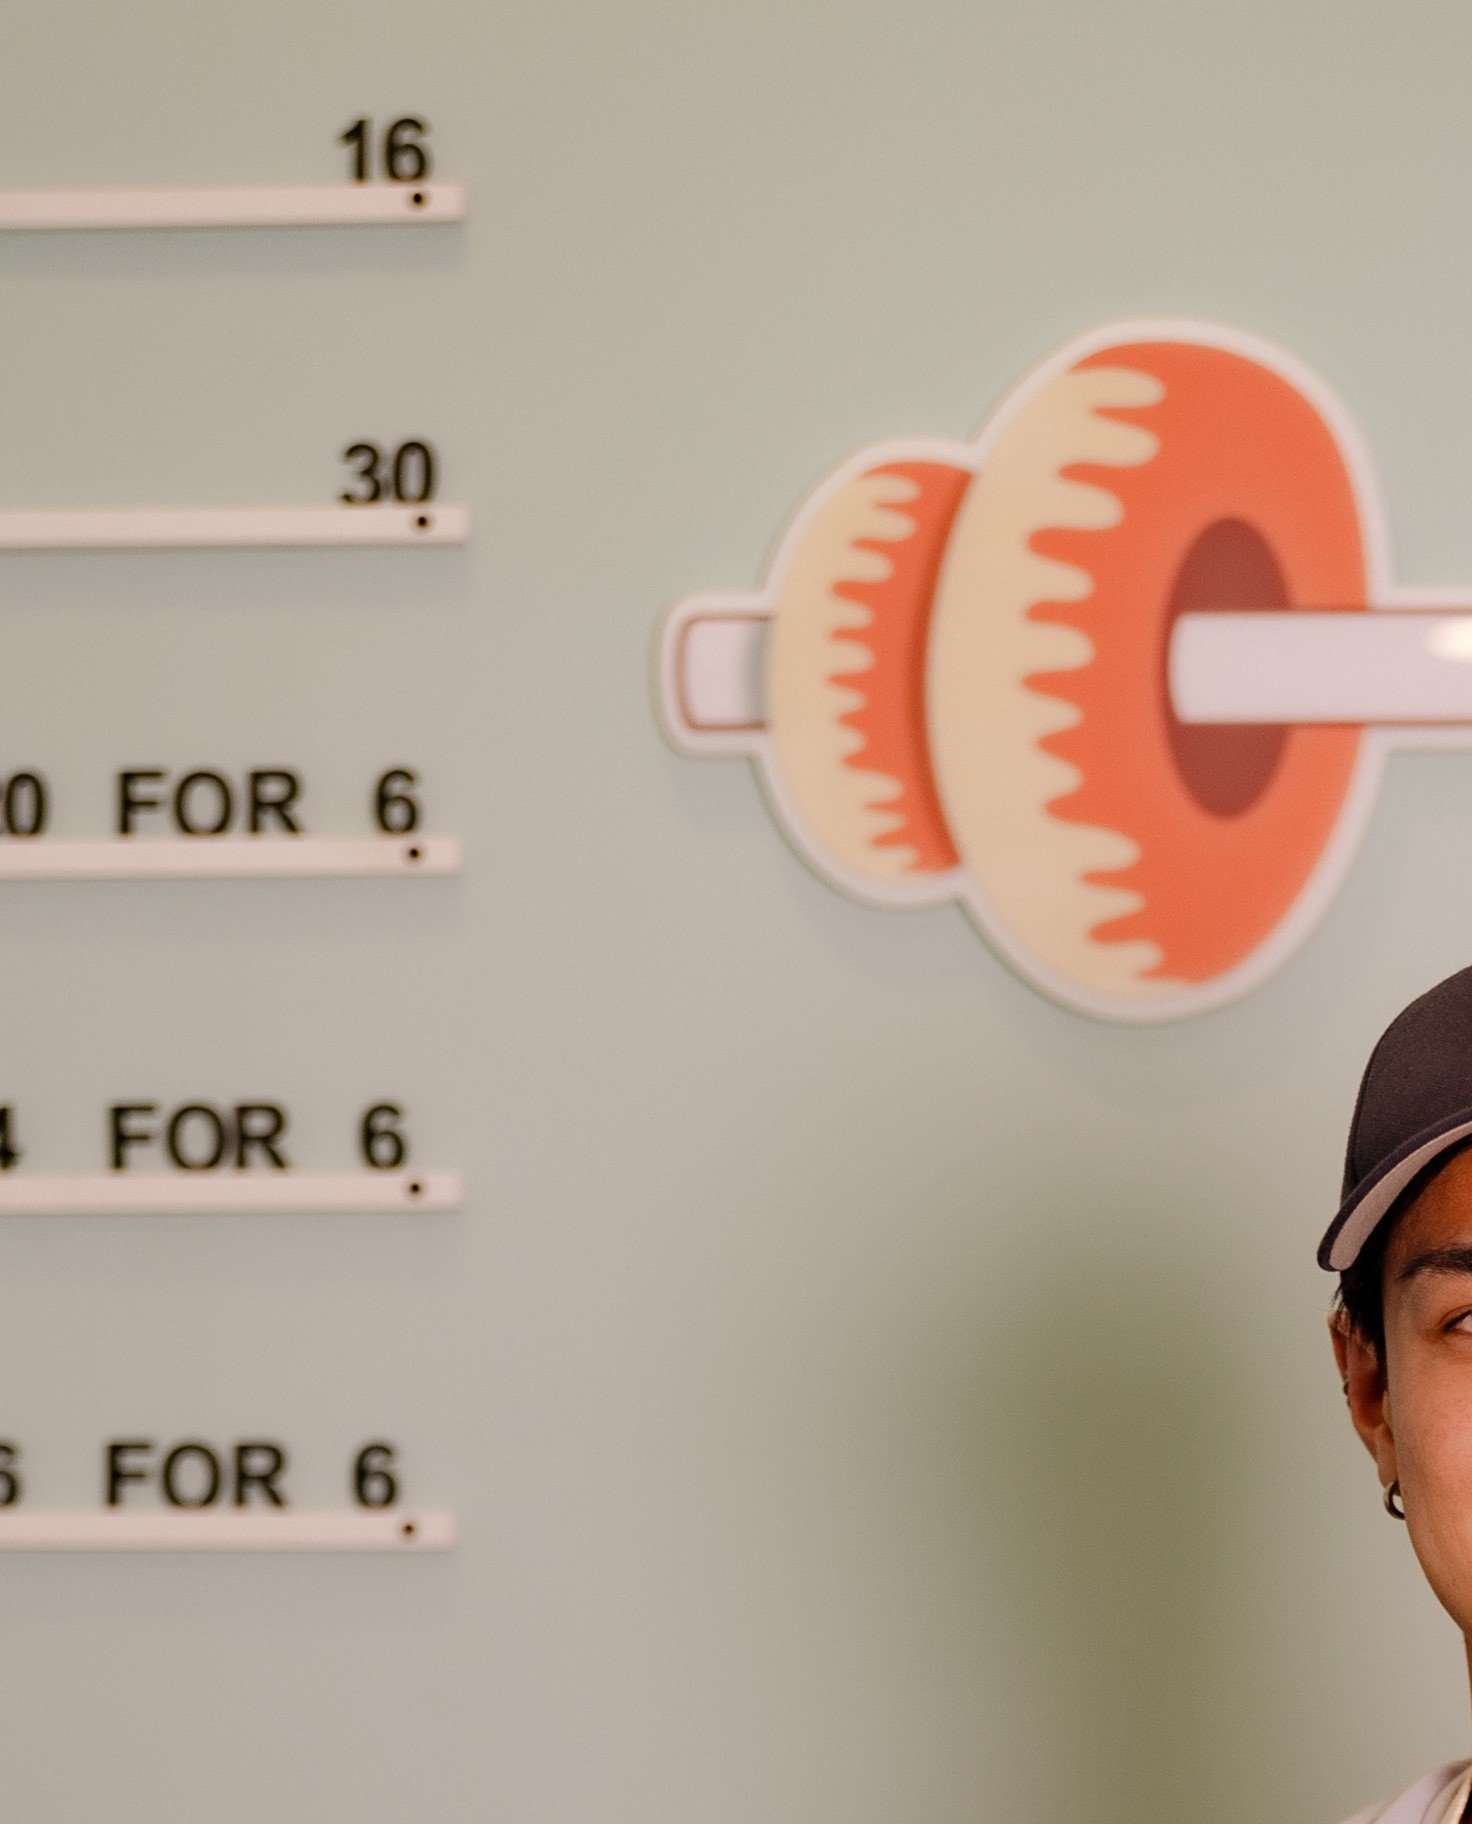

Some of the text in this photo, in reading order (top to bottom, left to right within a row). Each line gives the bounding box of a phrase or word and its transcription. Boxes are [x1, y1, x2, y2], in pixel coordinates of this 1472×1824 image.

[338, 116, 431, 184] 16
[339, 439, 438, 506] 30
[0, 767, 420, 837] 0 FOR 6
[108, 1102, 407, 1171] FOR 6
[104, 1441, 399, 1508] FOR 6
